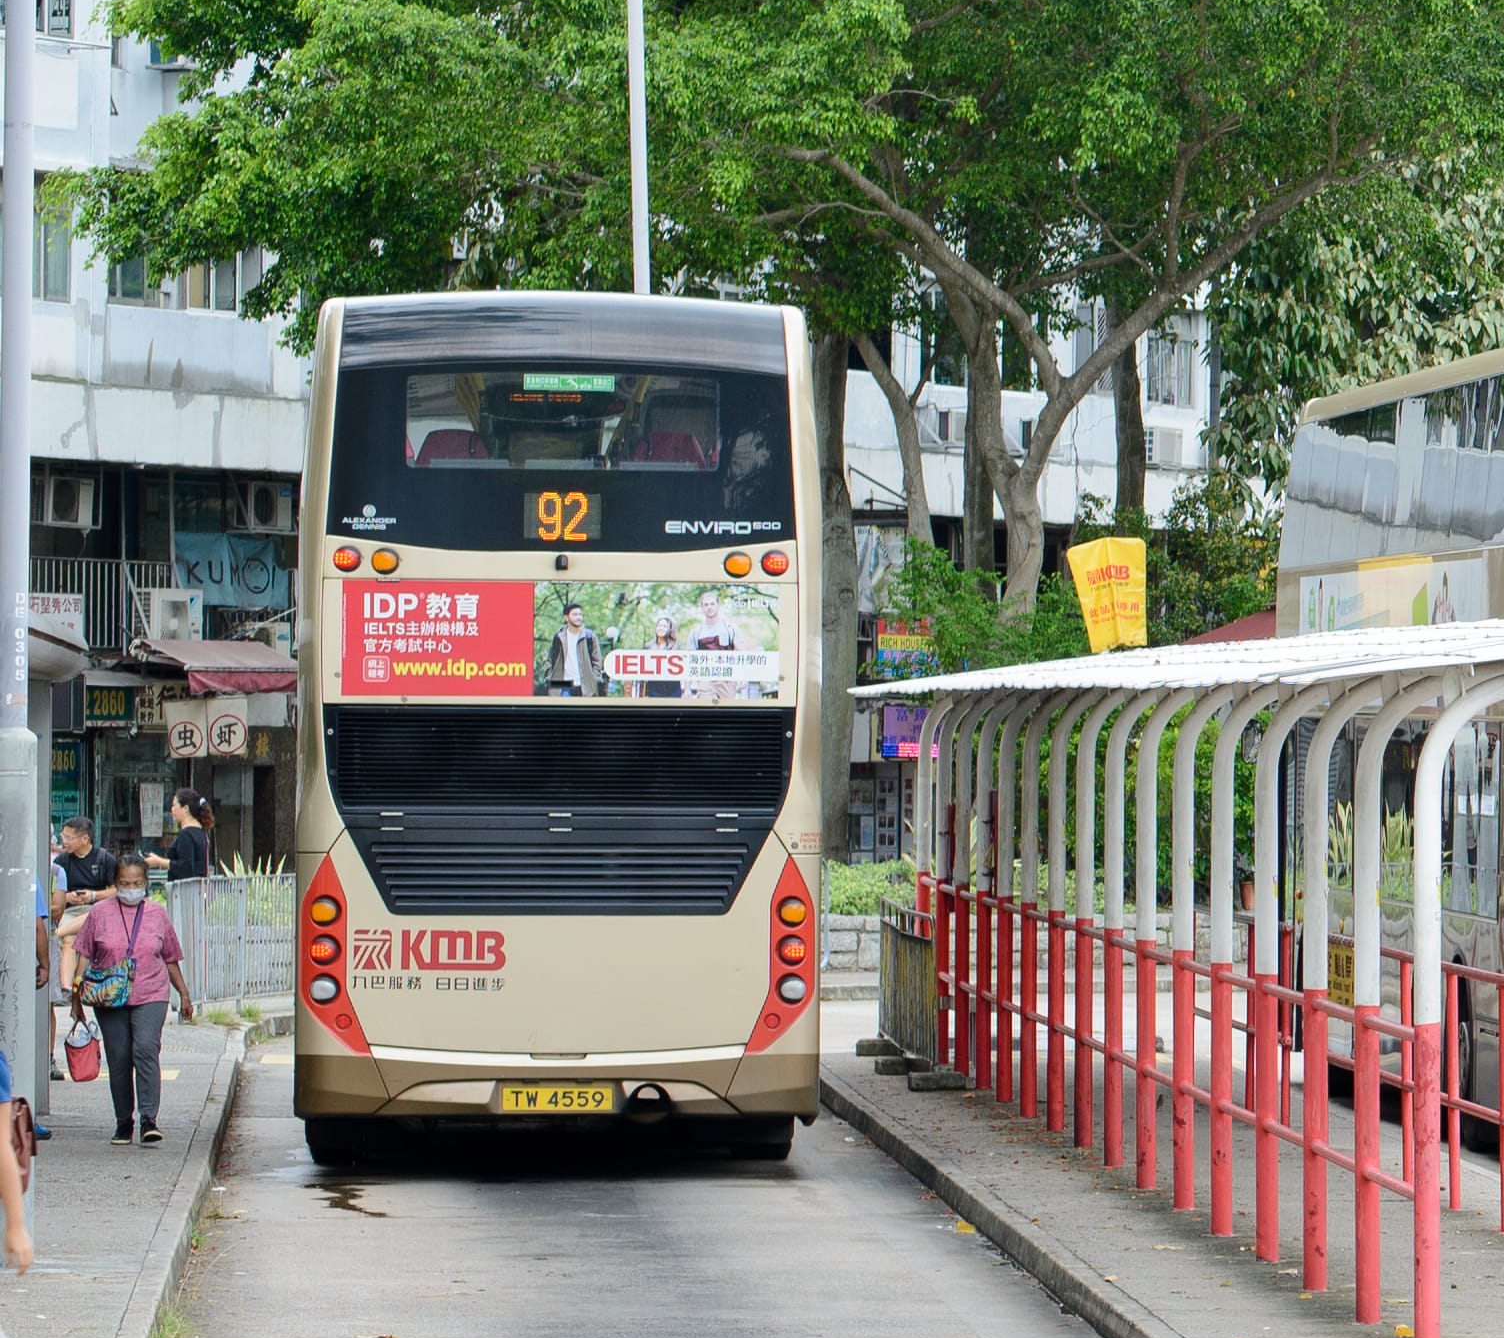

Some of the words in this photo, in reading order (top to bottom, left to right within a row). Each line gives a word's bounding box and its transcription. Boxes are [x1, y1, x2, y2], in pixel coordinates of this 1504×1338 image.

[342, 516, 396, 524] ALEXANDER
[537, 492, 588, 541] 92
[426, 592, 480, 619] 教育
[363, 638, 452, 653] 官方考試中心
[393, 659, 527, 679] www.idp.com
[615, 655, 684, 675] IELTS
[511, 1091, 537, 1107] TW
[547, 1091, 604, 1108] 4559
